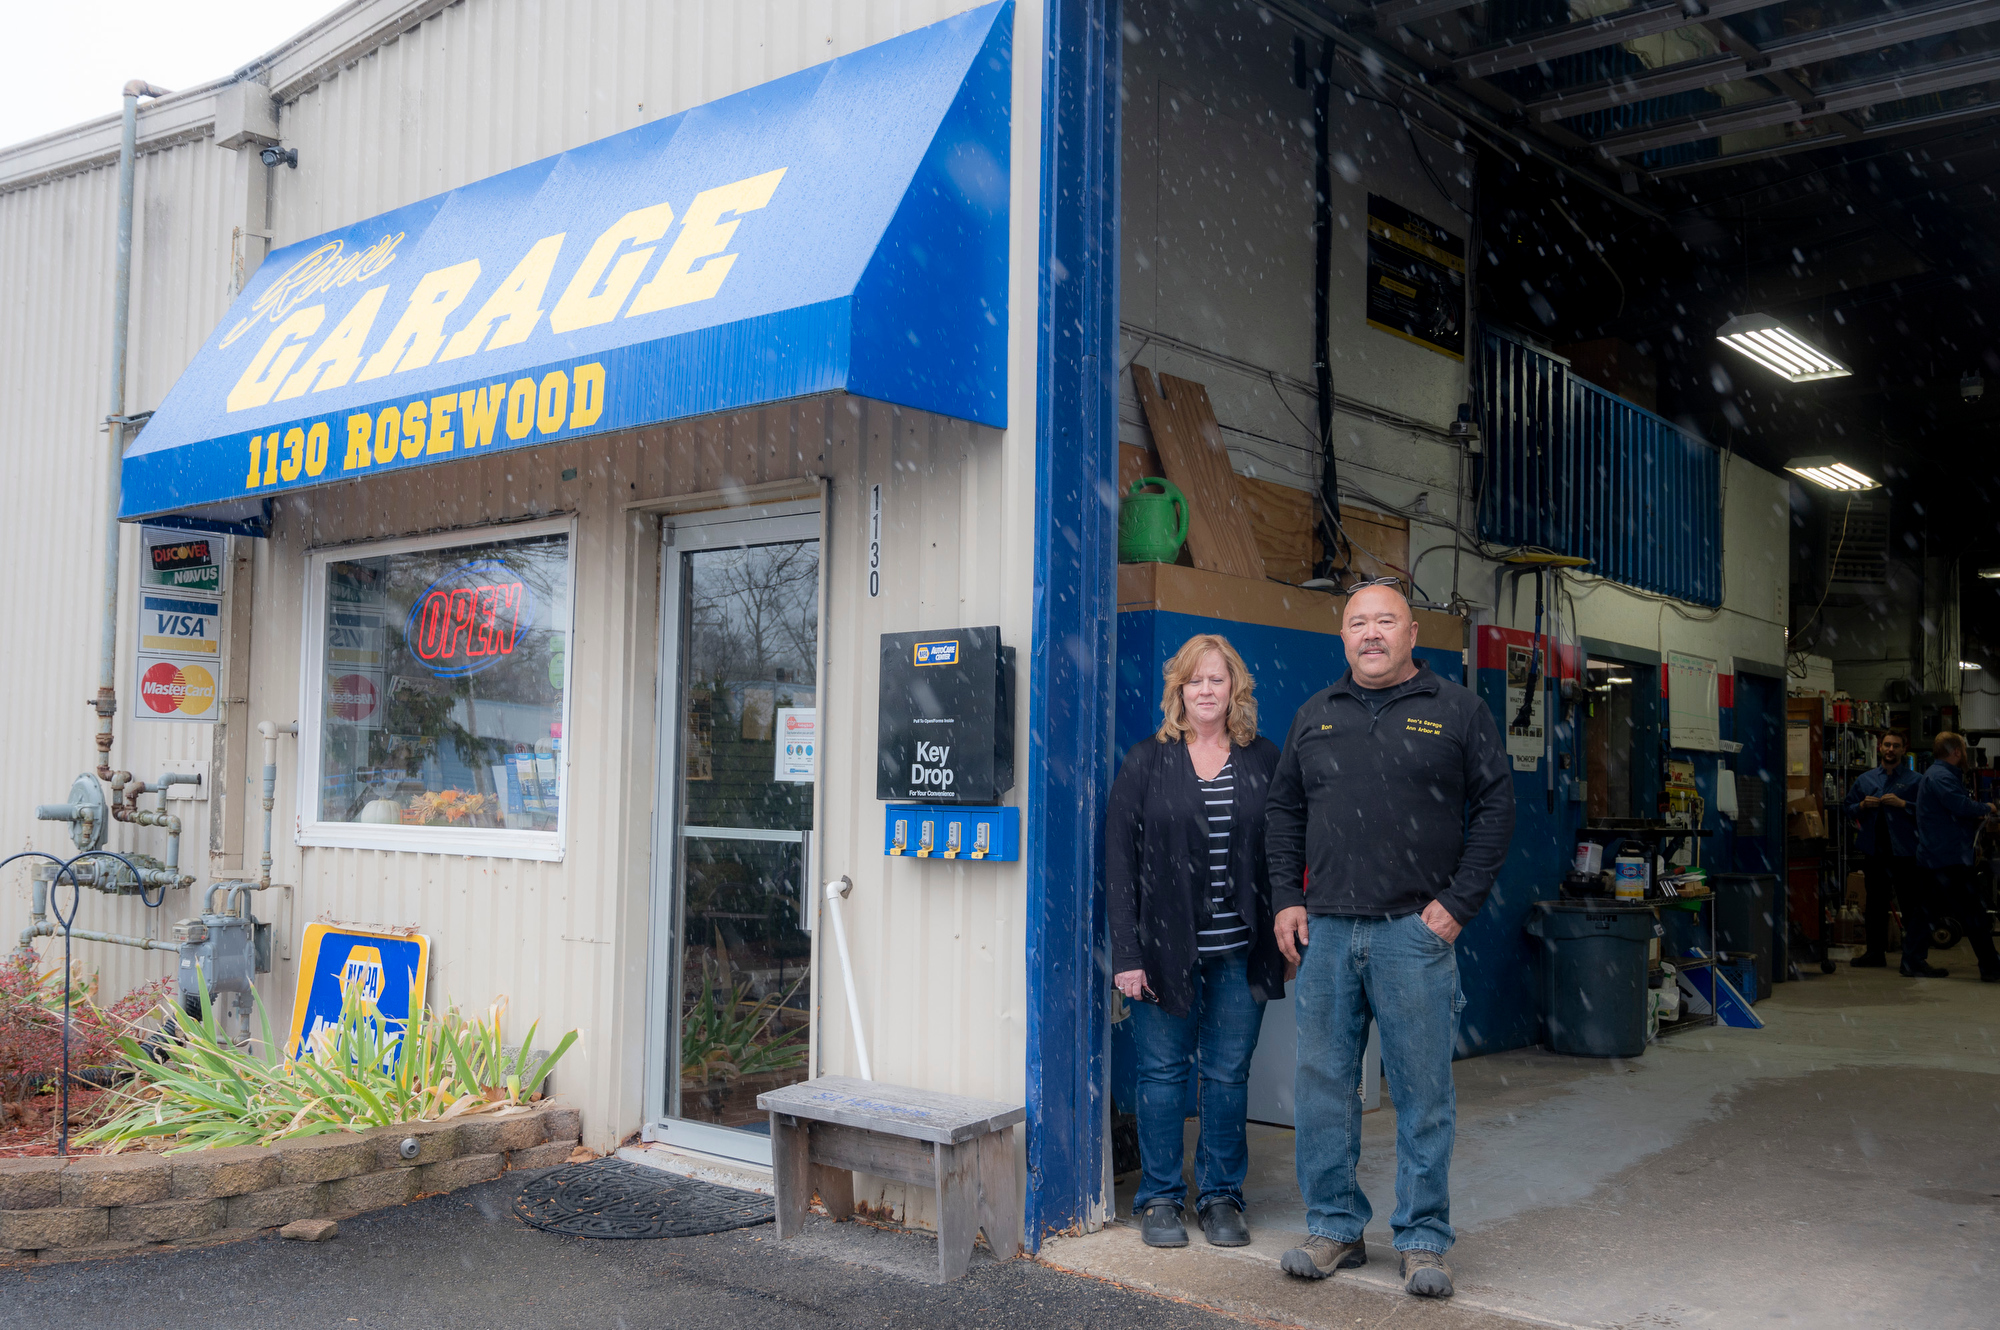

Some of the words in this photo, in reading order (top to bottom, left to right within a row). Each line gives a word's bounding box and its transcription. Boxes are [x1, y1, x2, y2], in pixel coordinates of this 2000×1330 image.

[226, 167, 788, 413] GARAGE
[245, 421, 331, 489] 1130
[343, 361, 606, 471] ROSEWOOD
[153, 544, 209, 562] DISCOVER
[870, 484, 880, 597] 1130
[157, 613, 205, 637] VISA
[418, 582, 523, 660] OPEN
[143, 681, 213, 698] MasterCard
[1424, 720, 1443, 729] Garage
[917, 741, 950, 767] Key
[911, 764, 954, 790] Drop
